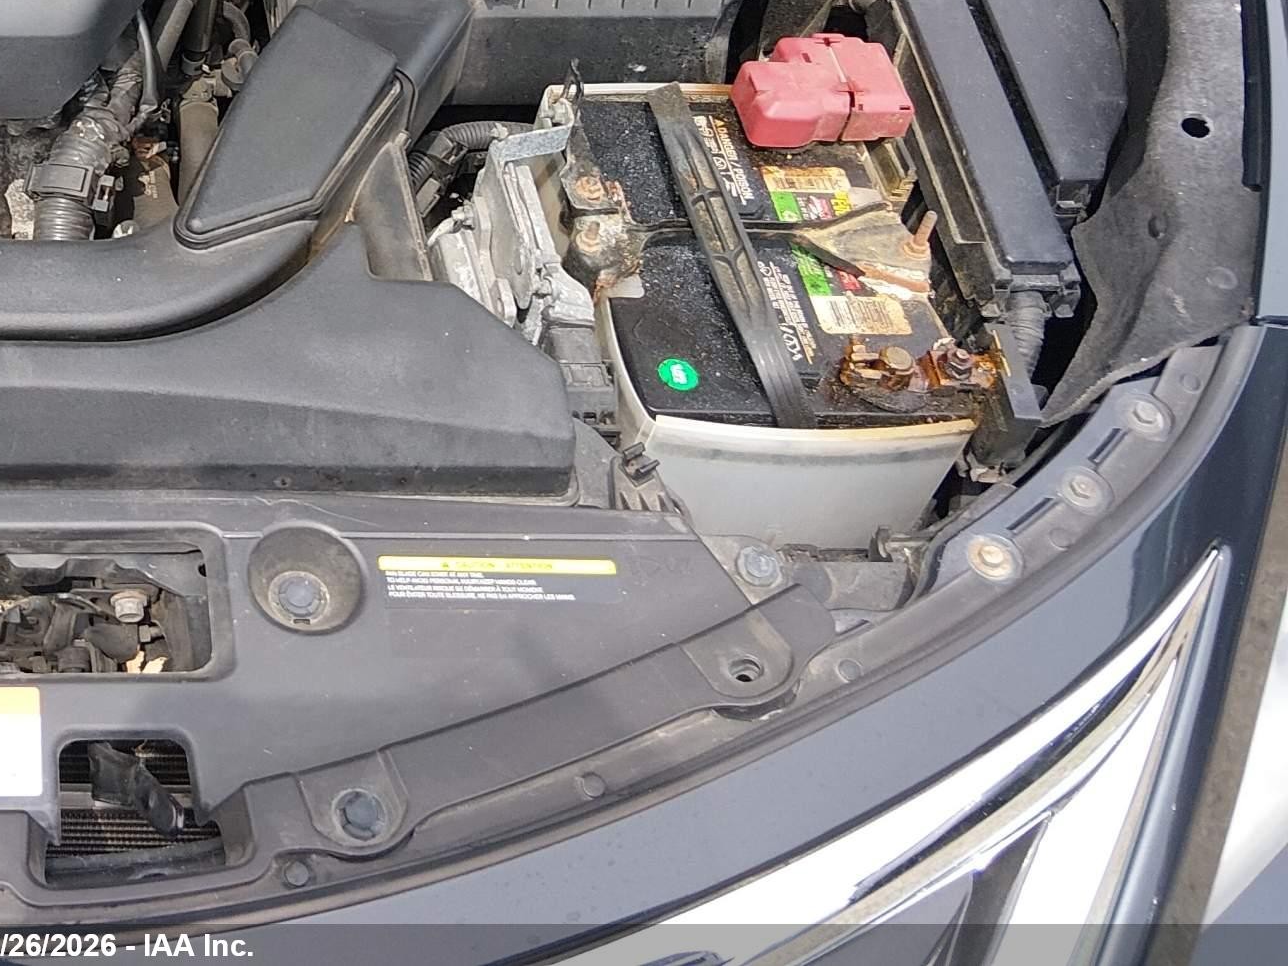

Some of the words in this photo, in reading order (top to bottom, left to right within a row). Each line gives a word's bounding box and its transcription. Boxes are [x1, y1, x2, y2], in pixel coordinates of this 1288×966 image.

[717, 127, 739, 161] DANGER
[733, 168, 755, 199] POISON
[456, 561, 495, 569] CAUTION
[505, 562, 552, 570] ATTENTION
